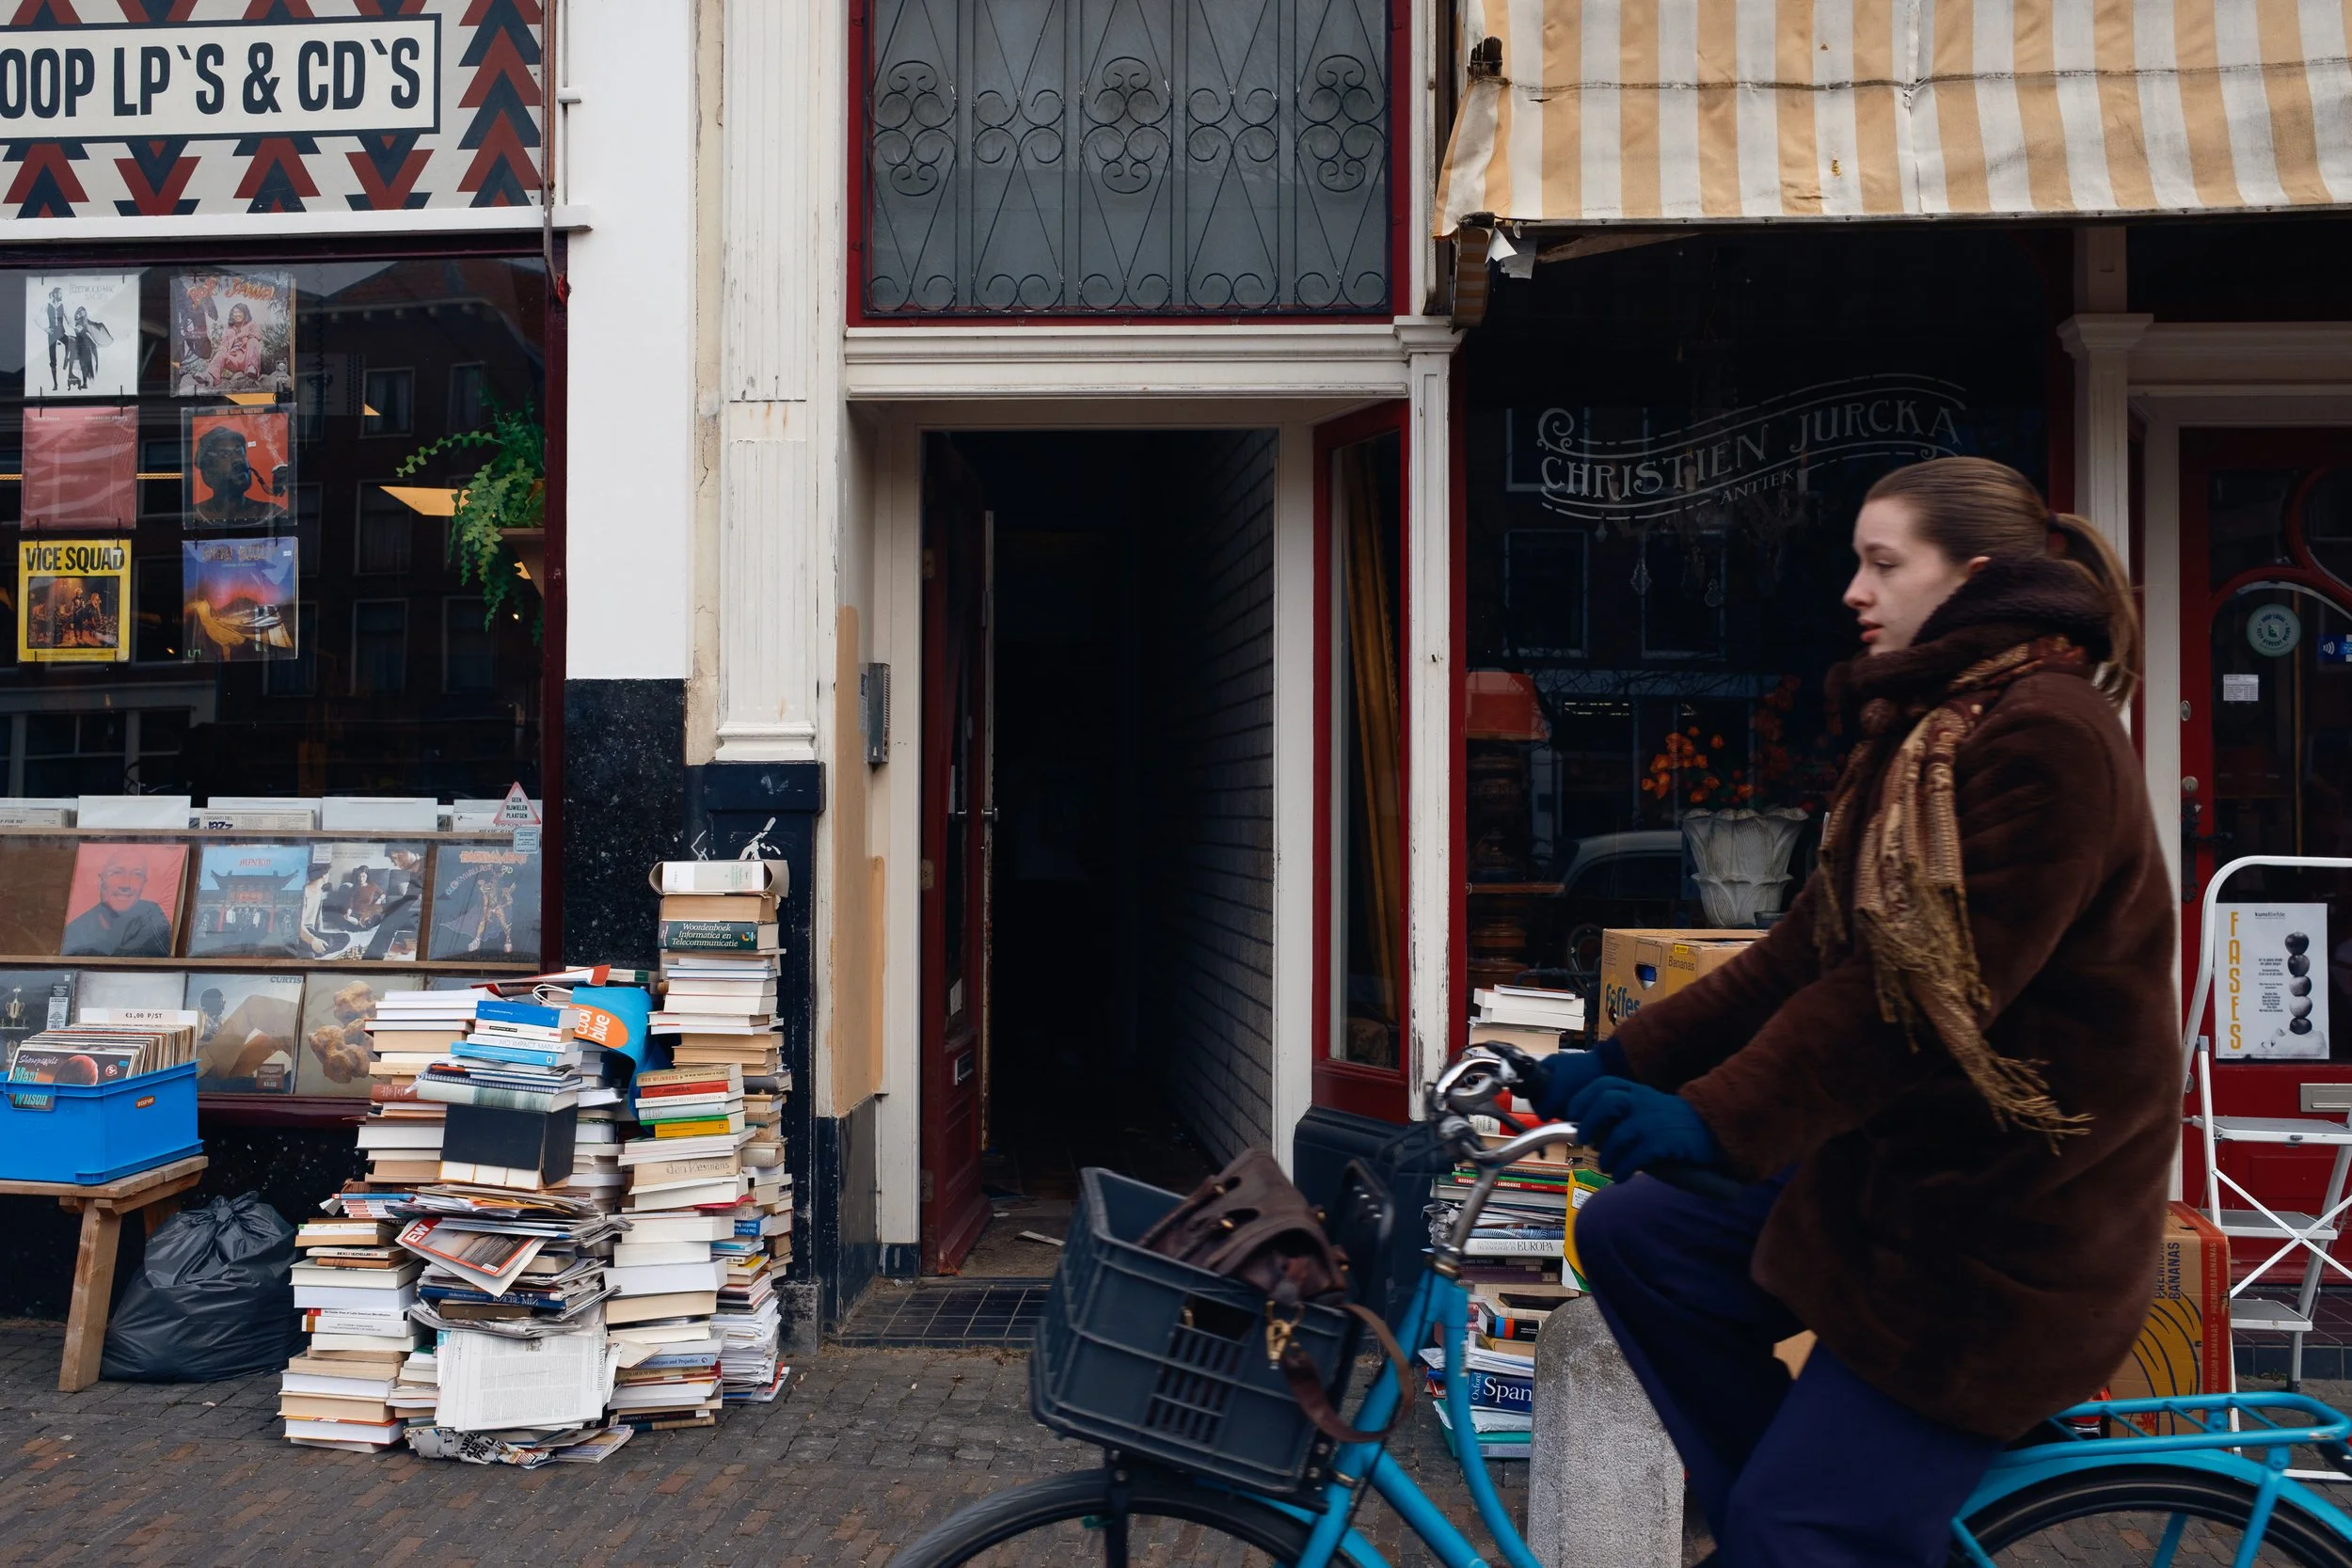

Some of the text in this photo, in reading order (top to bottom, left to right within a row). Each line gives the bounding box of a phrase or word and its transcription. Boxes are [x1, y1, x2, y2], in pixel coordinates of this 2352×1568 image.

[243, 42, 281, 114] &
[1540, 400, 1961, 500] CHRISTIEN JURCKA
[1718, 467, 1796, 506] ANTIEK
[25, 546, 125, 574] VICE SQUAD
[678, 930, 721, 939] Informatica
[683, 923, 731, 931] Woordenboek
[672, 938, 739, 947] Telecommunicatie
[1668, 956, 1695, 972] Bananas
[2228, 911, 2242, 1051] FASES
[575, 1008, 593, 1035] cool
[588, 1014, 611, 1042] blue
[1497, 1180, 1521, 1189] ZERBOMBT
[1517, 1241, 1554, 1252] EUROPA
[2209, 1242, 2217, 1275] BANANAS
[2168, 1242, 2181, 1300] BANANAS
[2210, 1275, 2218, 1314] PREMIUM
[2210, 1323, 2219, 1352] BANANAS
[1471, 1371, 1482, 1401] Oxford
[1484, 1376, 1533, 1403] Span
